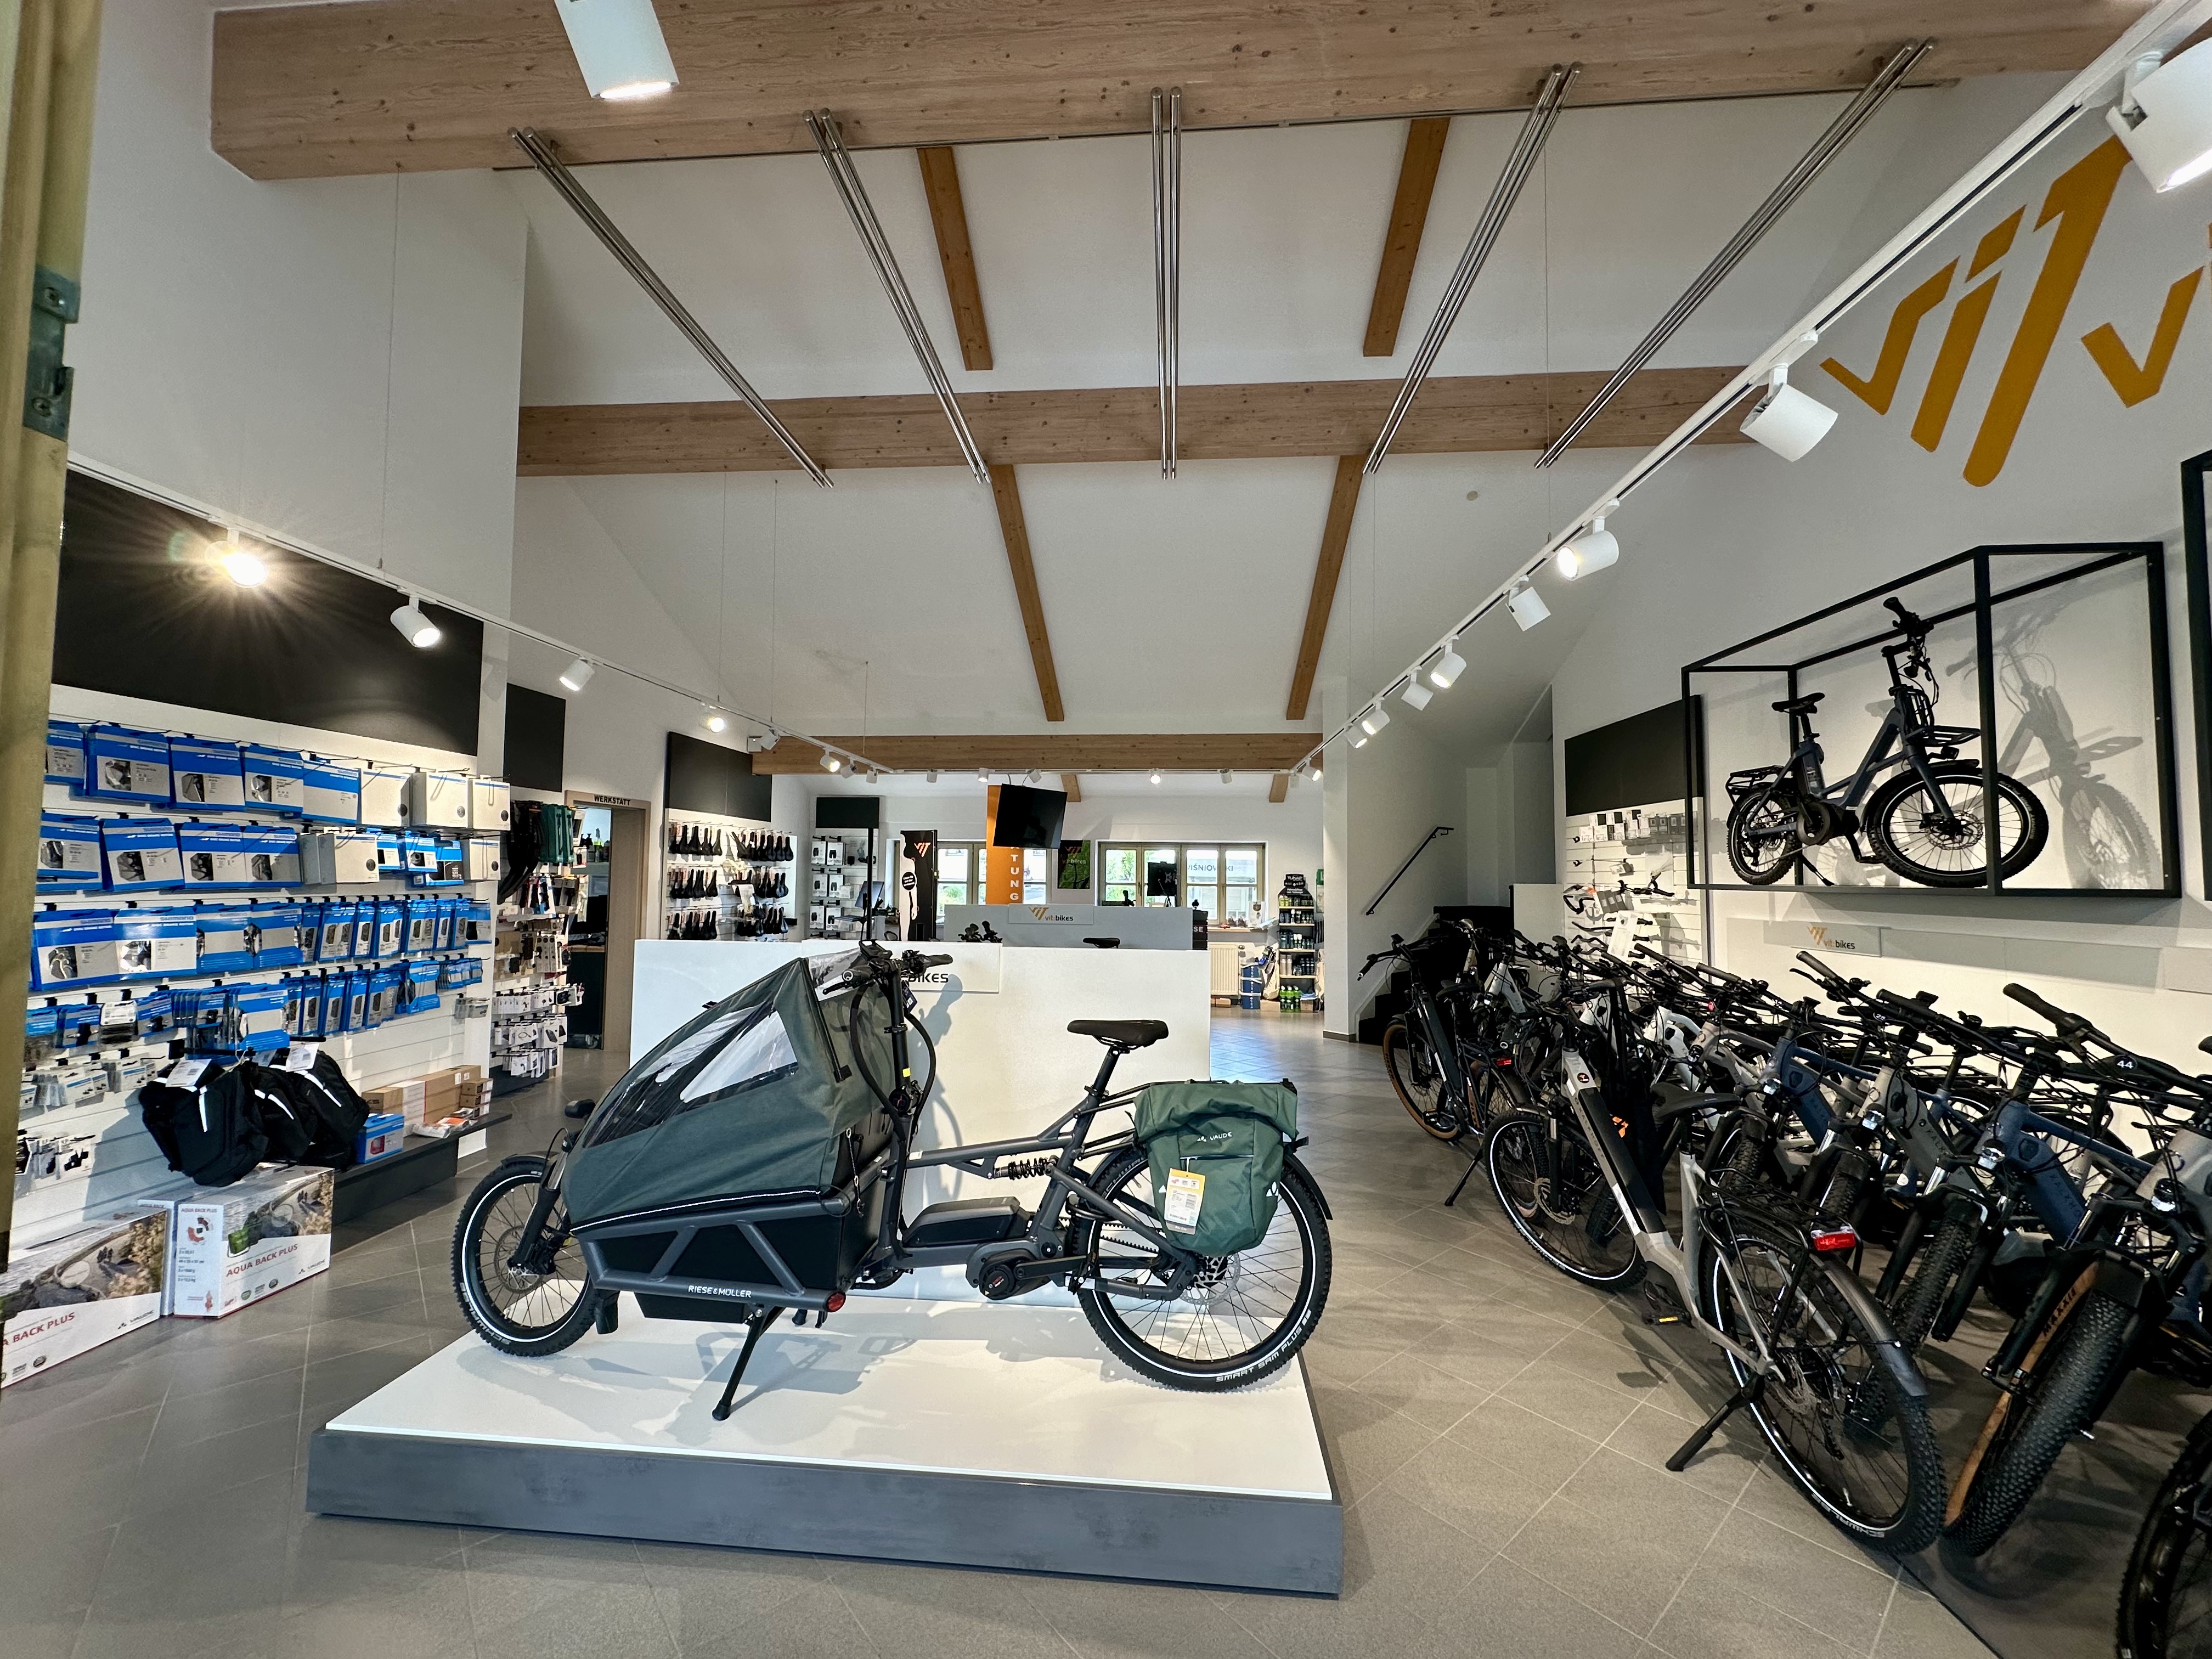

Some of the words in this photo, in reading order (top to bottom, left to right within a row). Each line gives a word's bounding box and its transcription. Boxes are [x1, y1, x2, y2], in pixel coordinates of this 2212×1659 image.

[594, 794, 631, 806] WERKSTATT
[2117, 1060, 2134, 1069] 44
[1209, 1131, 1232, 1141] VAUDE
[226, 1262, 253, 1277] AQUA
[255, 1251, 277, 1266] BACK
[279, 1243, 298, 1256] PLUS
[13, 1324, 44, 1343] BACK
[47, 1312, 75, 1330] PLUS
[1216, 1367, 1254, 1383] SMART
[1257, 1351, 1279, 1369] SAM
[1281, 1327, 1302, 1352] PLUS
